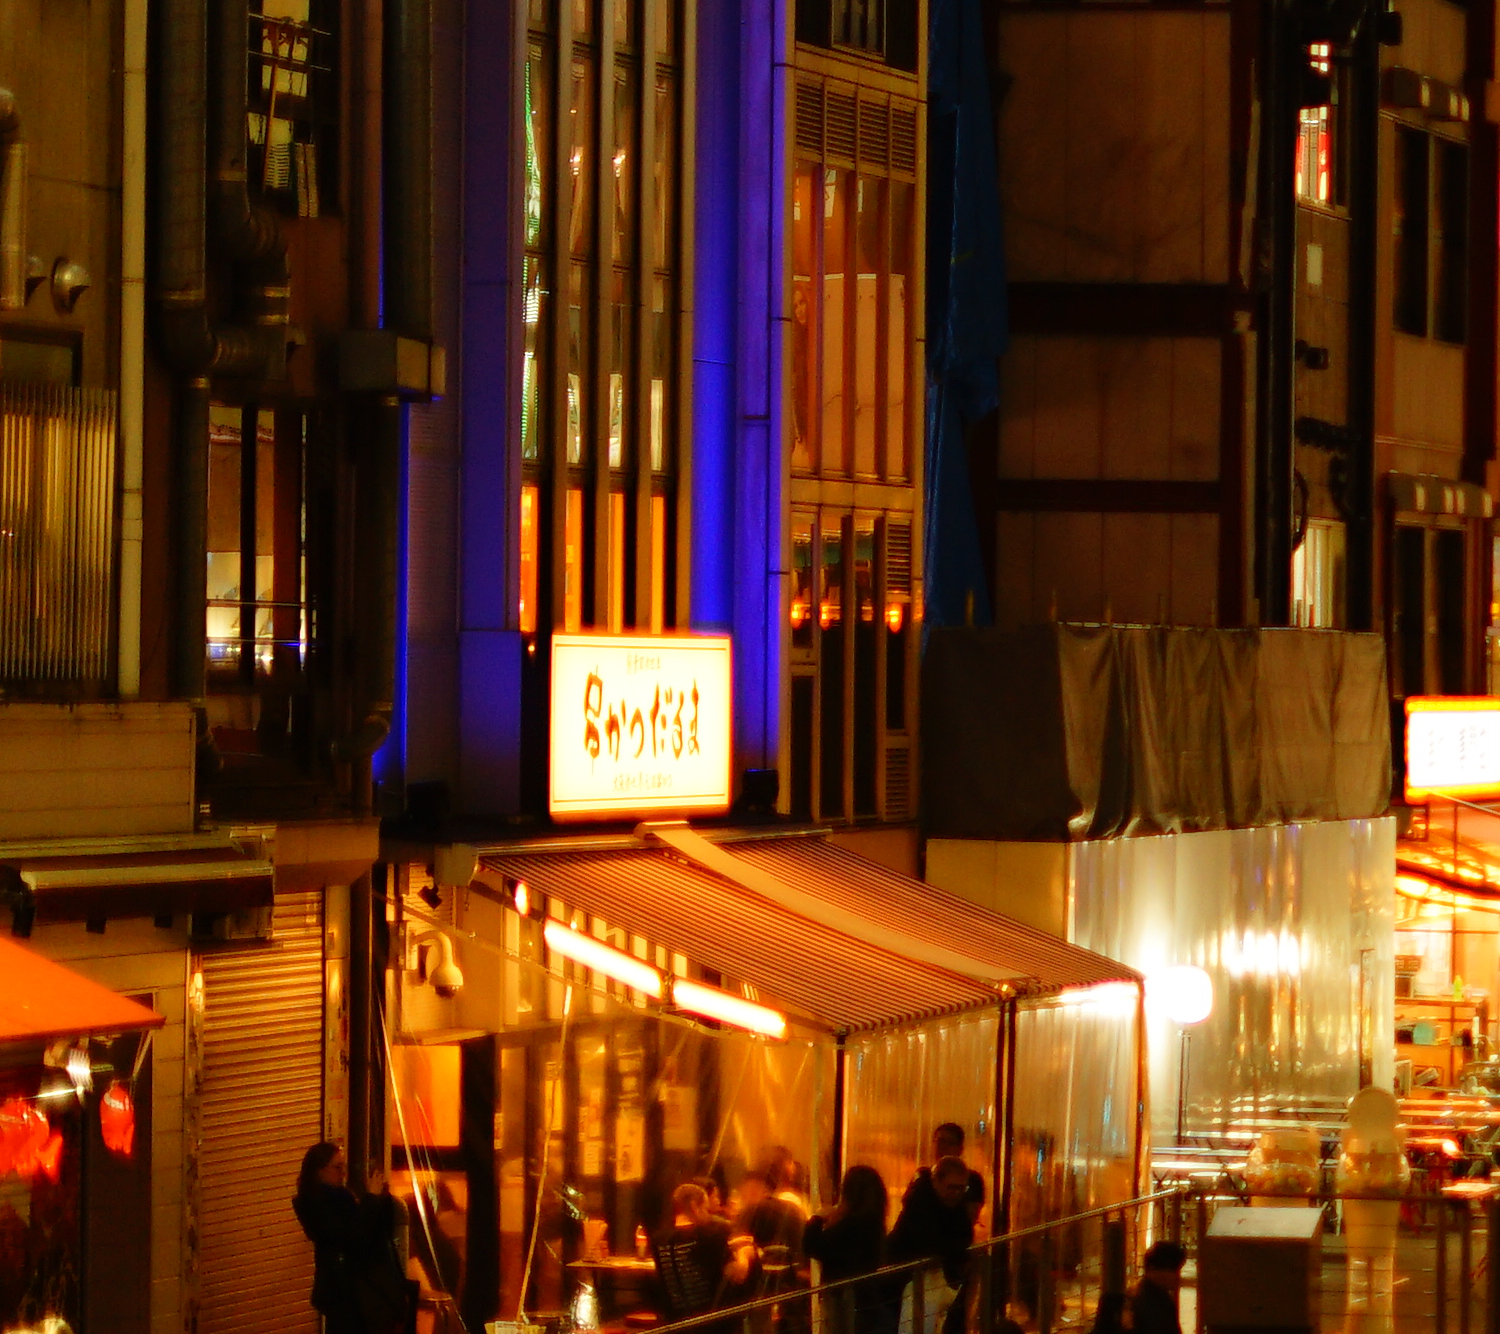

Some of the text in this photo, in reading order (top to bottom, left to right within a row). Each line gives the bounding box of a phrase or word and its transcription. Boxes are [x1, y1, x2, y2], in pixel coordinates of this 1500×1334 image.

[582, 664, 700, 775] 串かつだるま
